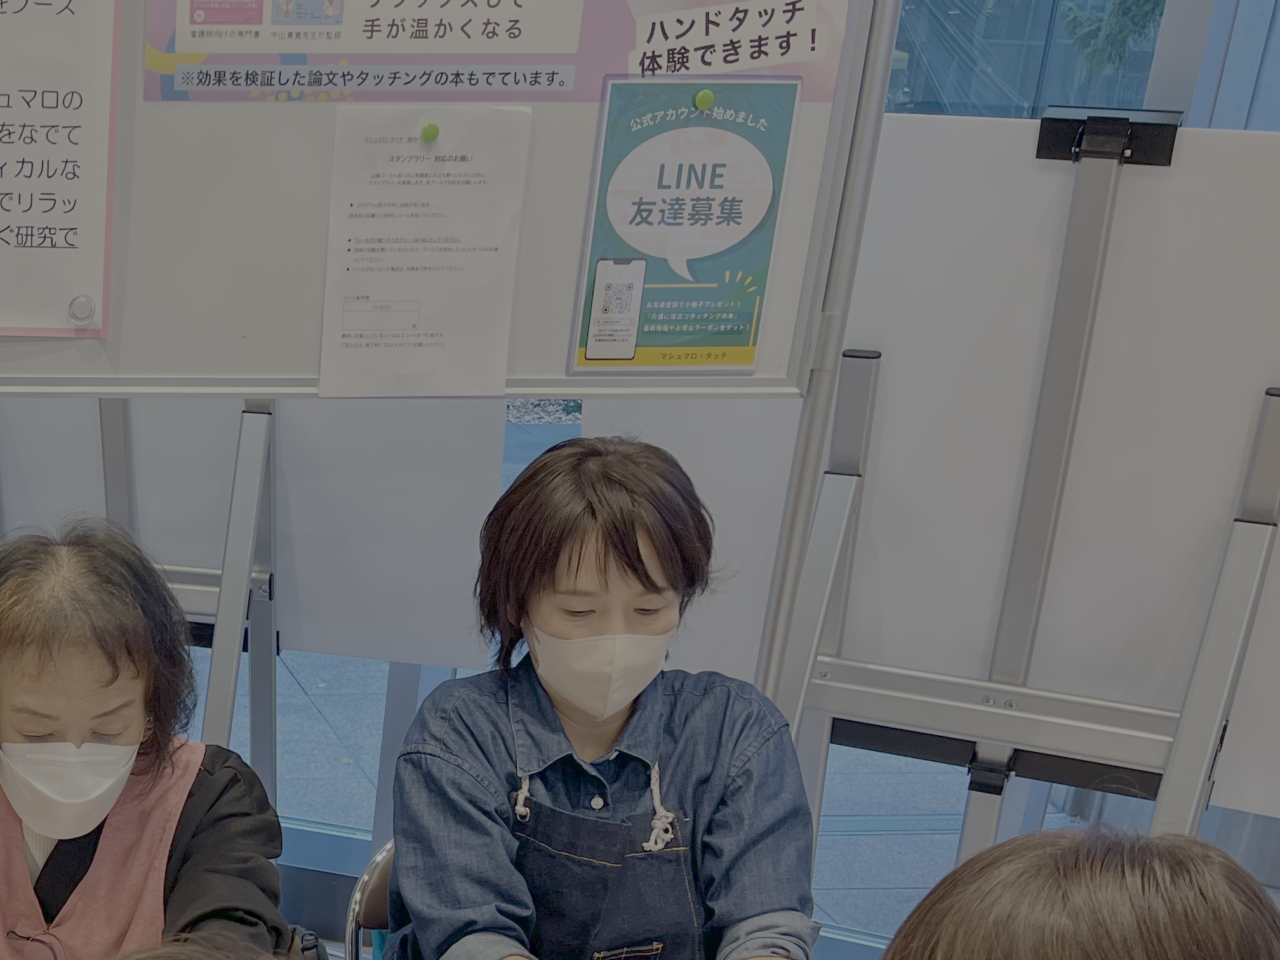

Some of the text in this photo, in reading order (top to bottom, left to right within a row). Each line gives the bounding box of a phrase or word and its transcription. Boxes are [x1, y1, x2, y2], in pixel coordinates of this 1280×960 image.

[362, 17, 522, 40] 手が温かくなる
[645, 0, 805, 44] ハンドタッチ
[638, 28, 817, 78] 体験できます！
[630, 106, 768, 132] 公式アカウント始めました
[657, 163, 727, 190] LINE
[628, 196, 743, 226] 友達募集
[660, 352, 728, 361] マシュマロ・タッチ
